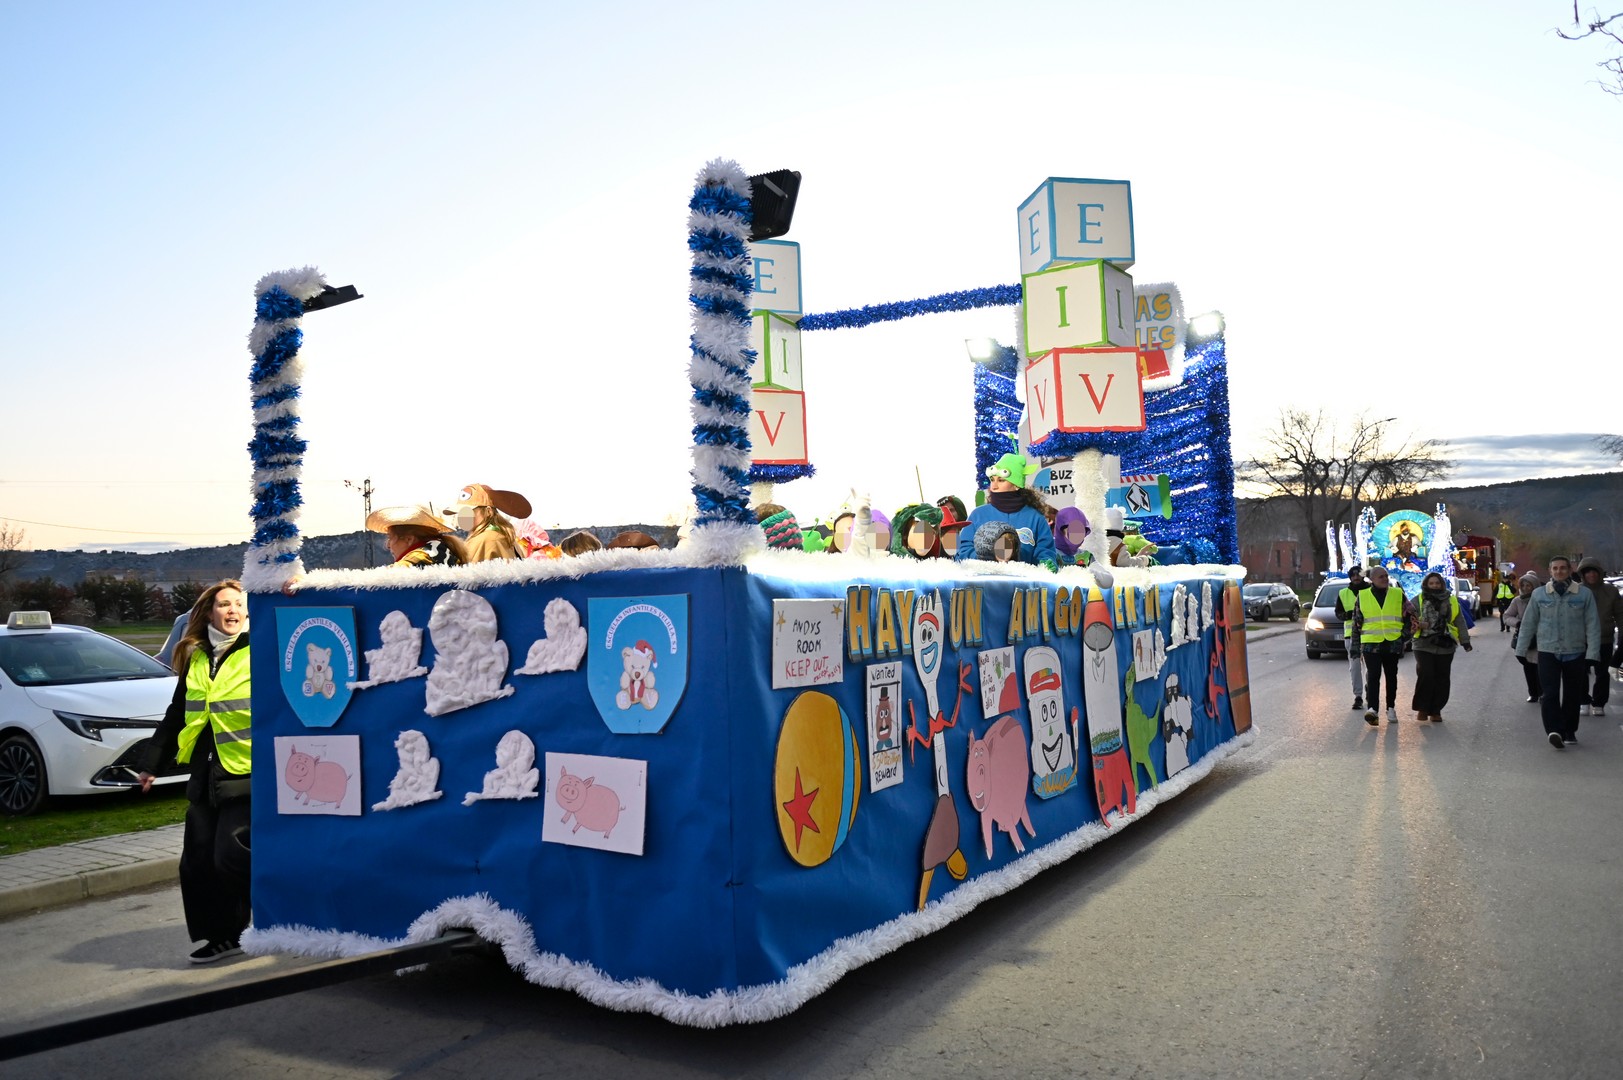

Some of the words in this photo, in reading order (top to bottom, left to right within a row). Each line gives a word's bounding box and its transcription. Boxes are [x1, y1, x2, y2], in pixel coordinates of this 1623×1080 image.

[1028, 210, 1041, 256] E
[1077, 203, 1104, 244] E
[752, 256, 777, 295] E
[1056, 285, 1071, 328] I
[1115, 288, 1124, 329] I
[781, 337, 788, 374] I
[1033, 378, 1047, 421] V
[1078, 373, 1115, 415] V
[755, 409, 786, 447] V
[1050, 469, 1074, 481] BUZ
[606, 614, 623, 648] ESCUELAS
[622, 605, 658, 616] INFANTILES
[846, 585, 915, 662] HAY
[950, 586, 983, 652] UN
[1007, 584, 1082, 645] AMIGO
[1113, 584, 1138, 630] EN
[796, 639, 821, 654] ROOM
[785, 658, 811, 679] KEEP
